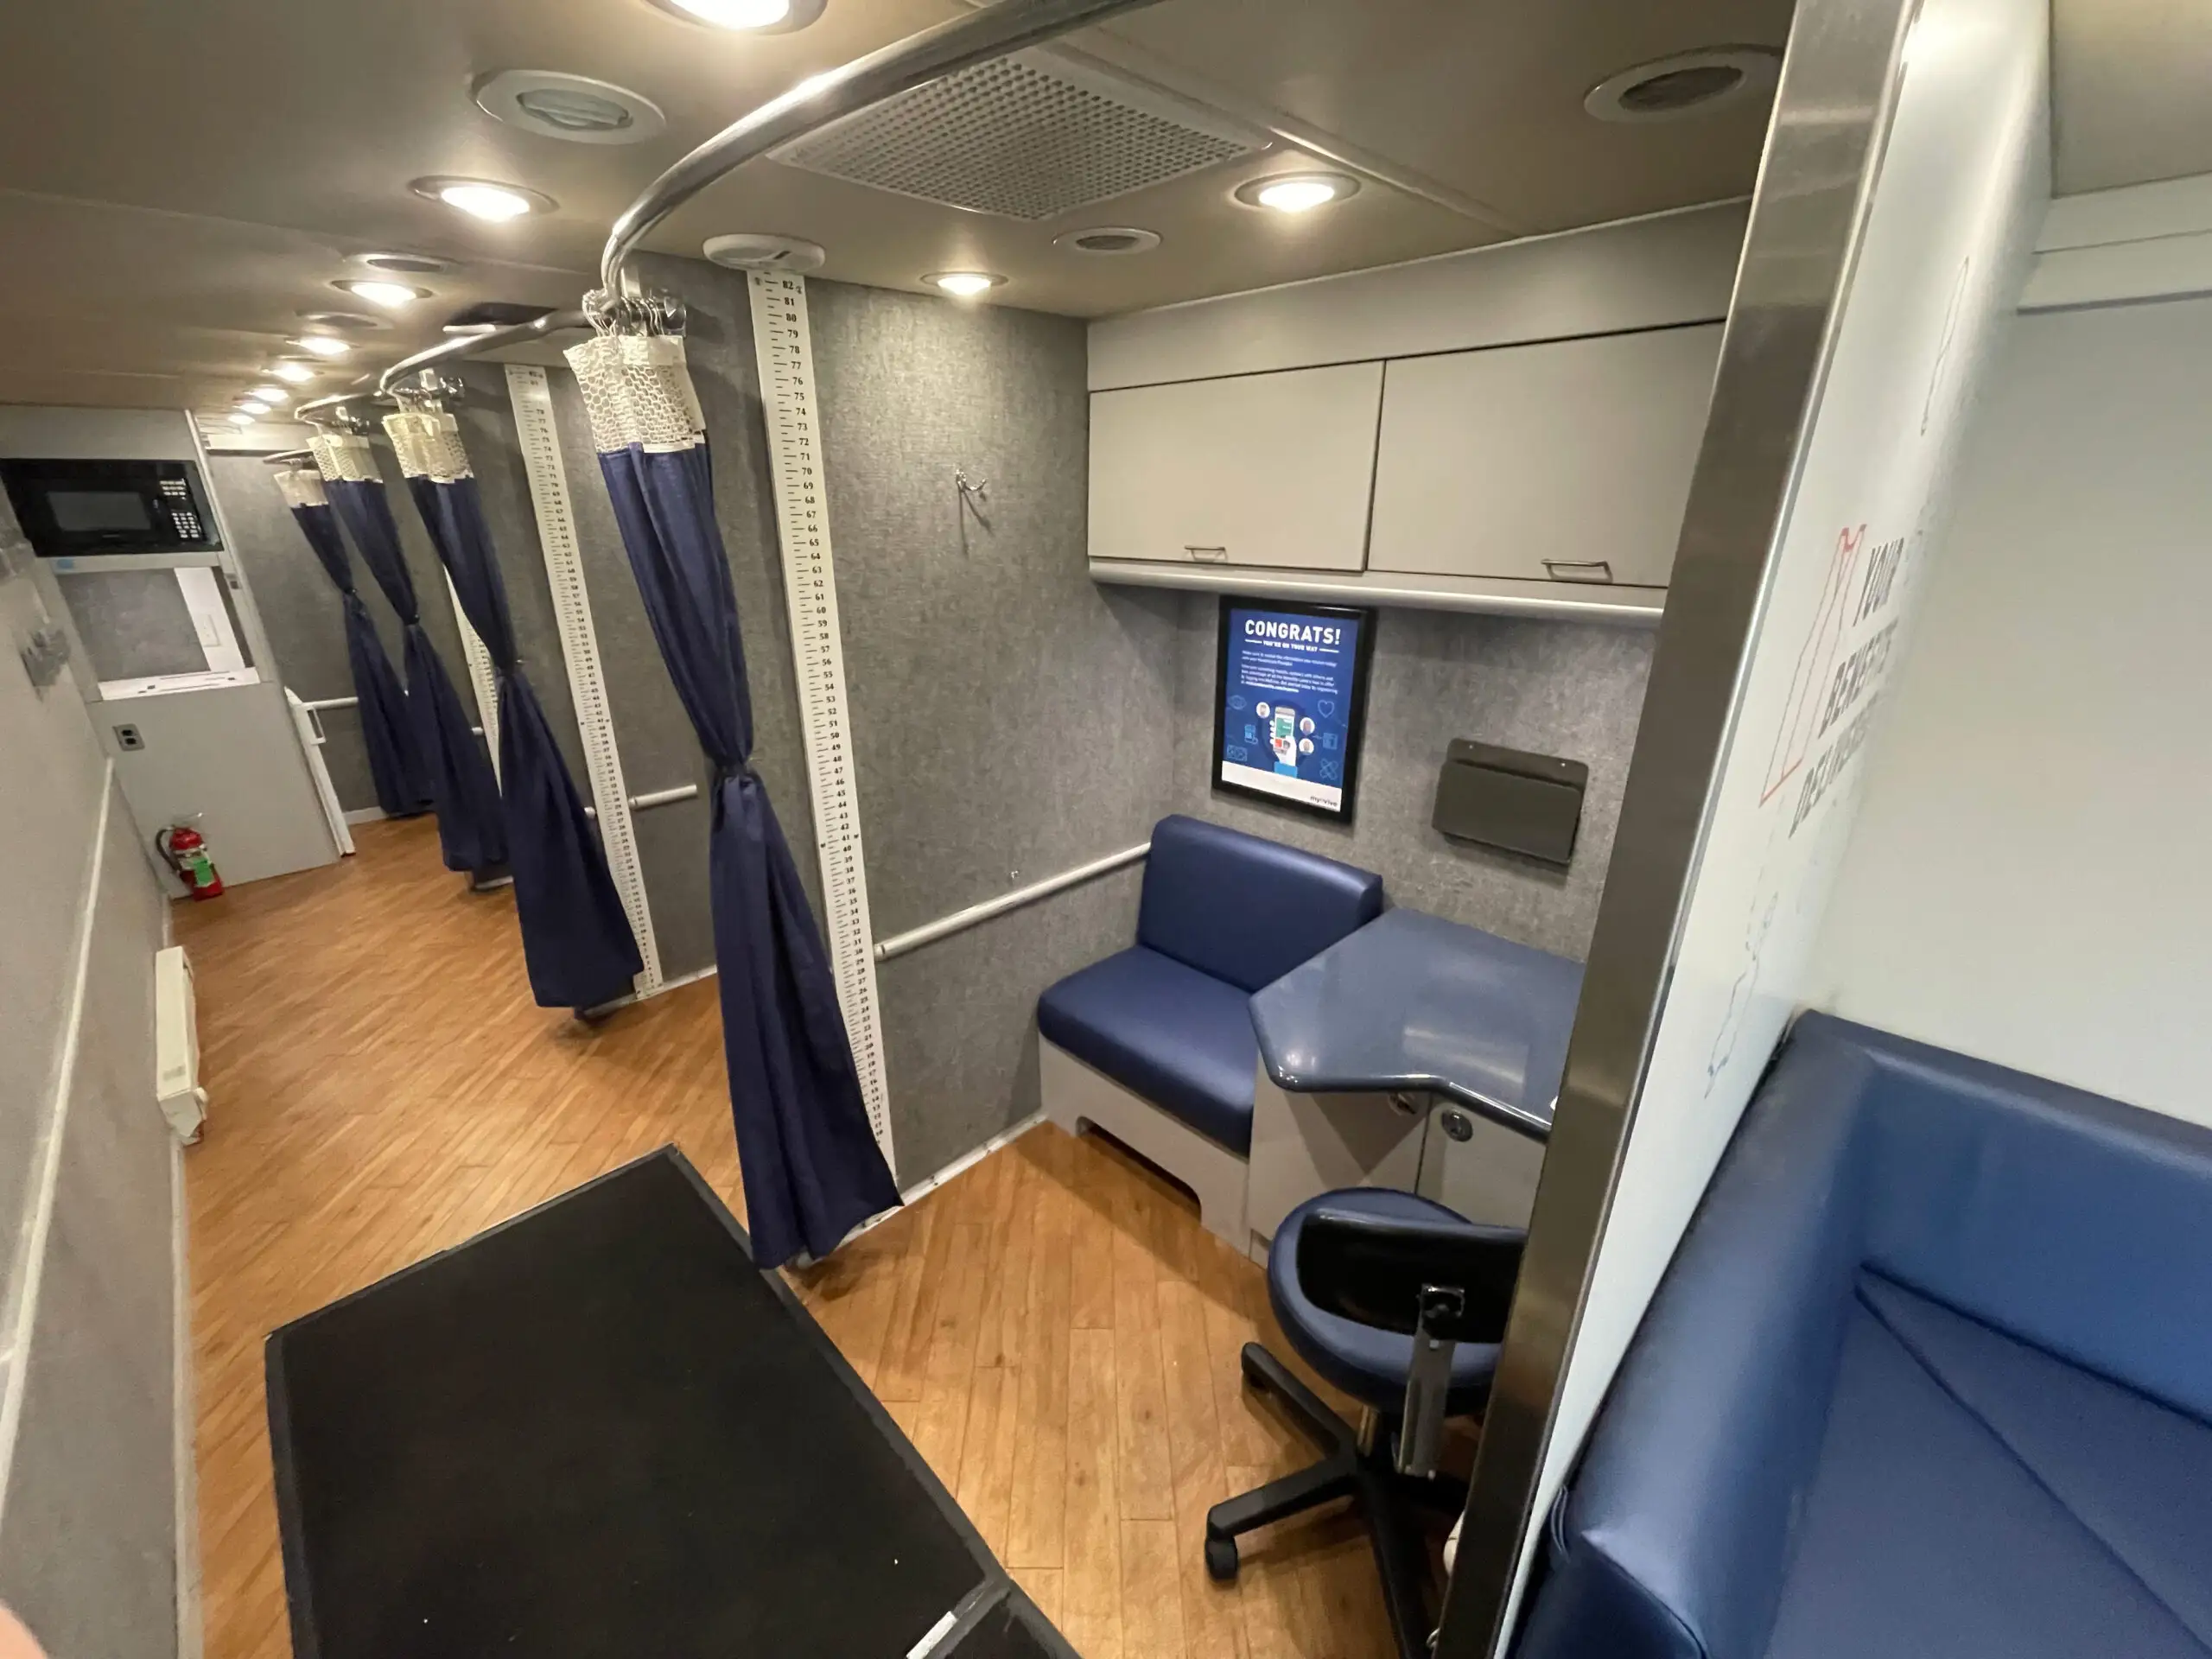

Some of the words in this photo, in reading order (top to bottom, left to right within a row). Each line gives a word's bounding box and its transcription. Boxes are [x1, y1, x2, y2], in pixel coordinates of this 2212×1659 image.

[782, 280, 793, 289] 82
[784, 296, 794, 306] 81
[785, 313, 797, 322] 80
[787, 328, 798, 338] 79
[789, 345, 799, 354] 78
[791, 360, 801, 369] 77
[792, 376, 803, 385] 76
[794, 391, 804, 400] 75
[796, 407, 805, 416] 74
[797, 422, 808, 430] 73
[798, 437, 809, 446] 72
[800, 452, 810, 461] 71
[806, 510, 816, 518] 67
[1244, 620, 1341, 645] CONGRATS!
[820, 645, 830, 653] 57
[822, 658, 831, 666] 56
